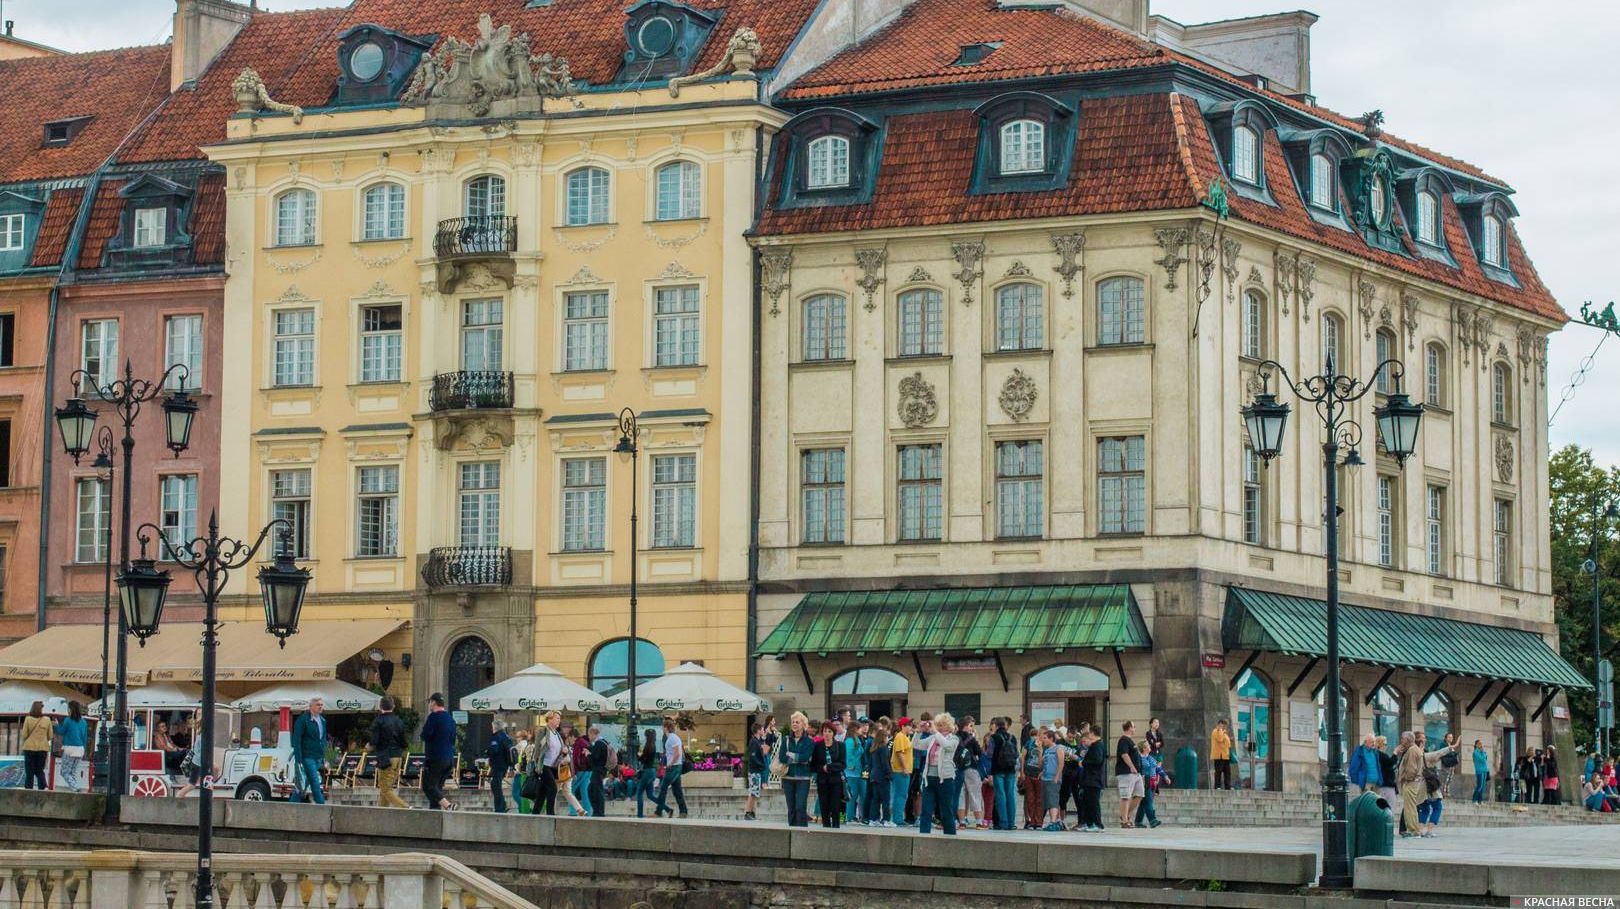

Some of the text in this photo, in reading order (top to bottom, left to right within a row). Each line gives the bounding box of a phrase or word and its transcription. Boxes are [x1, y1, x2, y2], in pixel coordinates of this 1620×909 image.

[518, 697, 548, 710] Carlsberg
[655, 698, 685, 710] Carlsberg
[716, 698, 743, 711] Carlsberg
